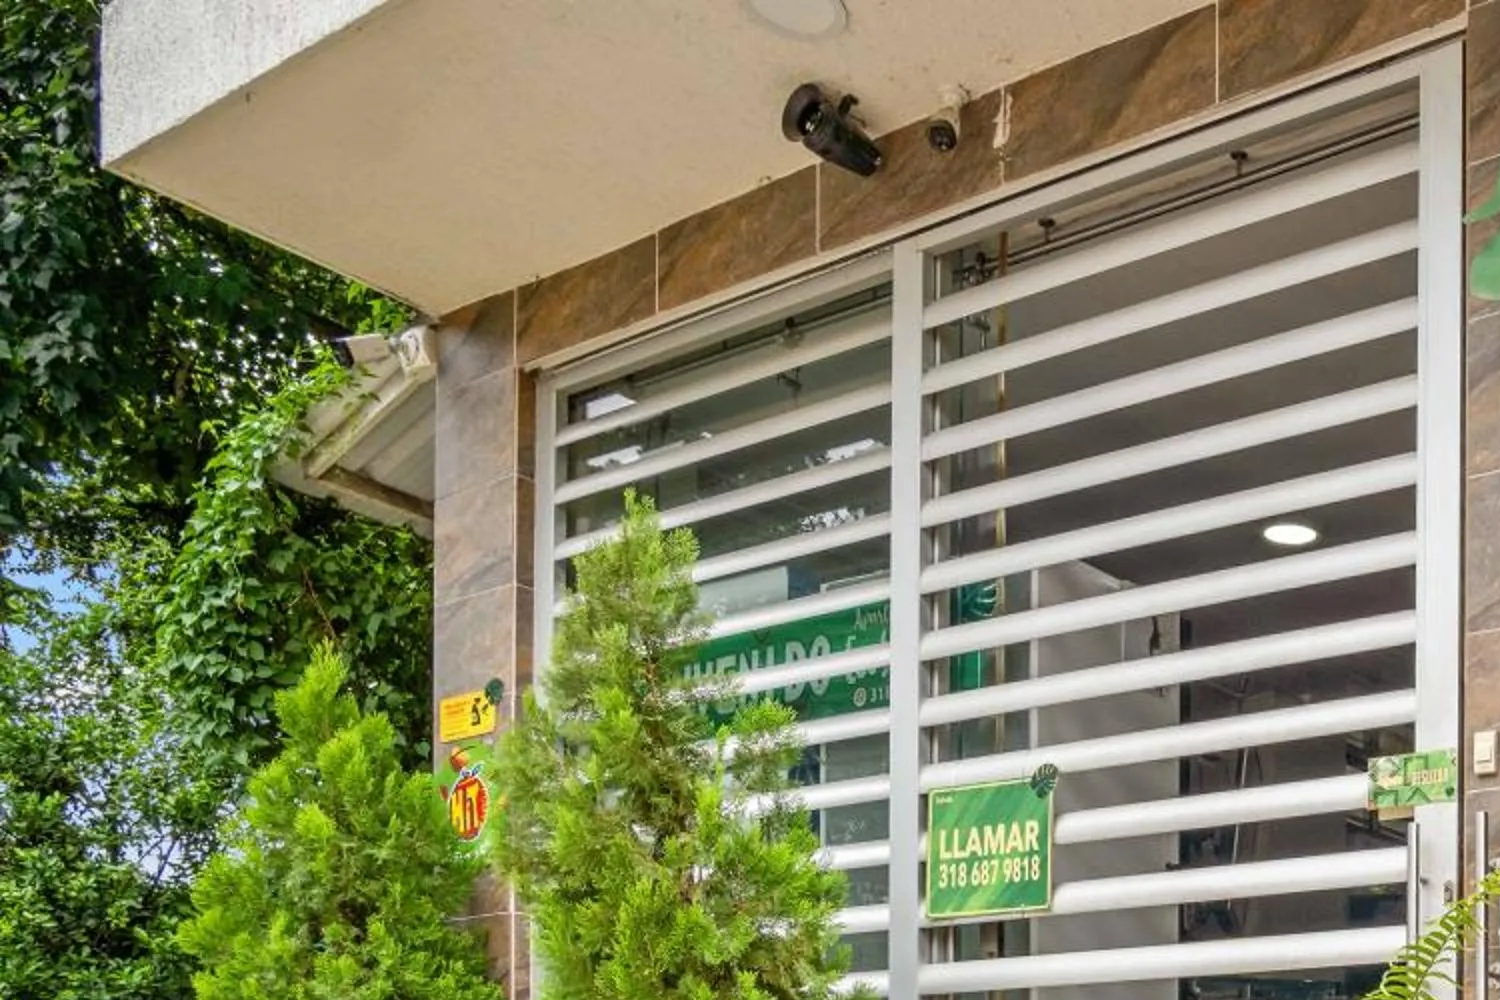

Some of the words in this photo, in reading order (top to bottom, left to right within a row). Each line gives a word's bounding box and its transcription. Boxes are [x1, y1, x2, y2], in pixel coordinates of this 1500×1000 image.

[938, 819, 1040, 861] LLAMAR
[938, 862, 968, 890] 318
[971, 859, 999, 887] 687
[1003, 854, 1041, 883] 9818
